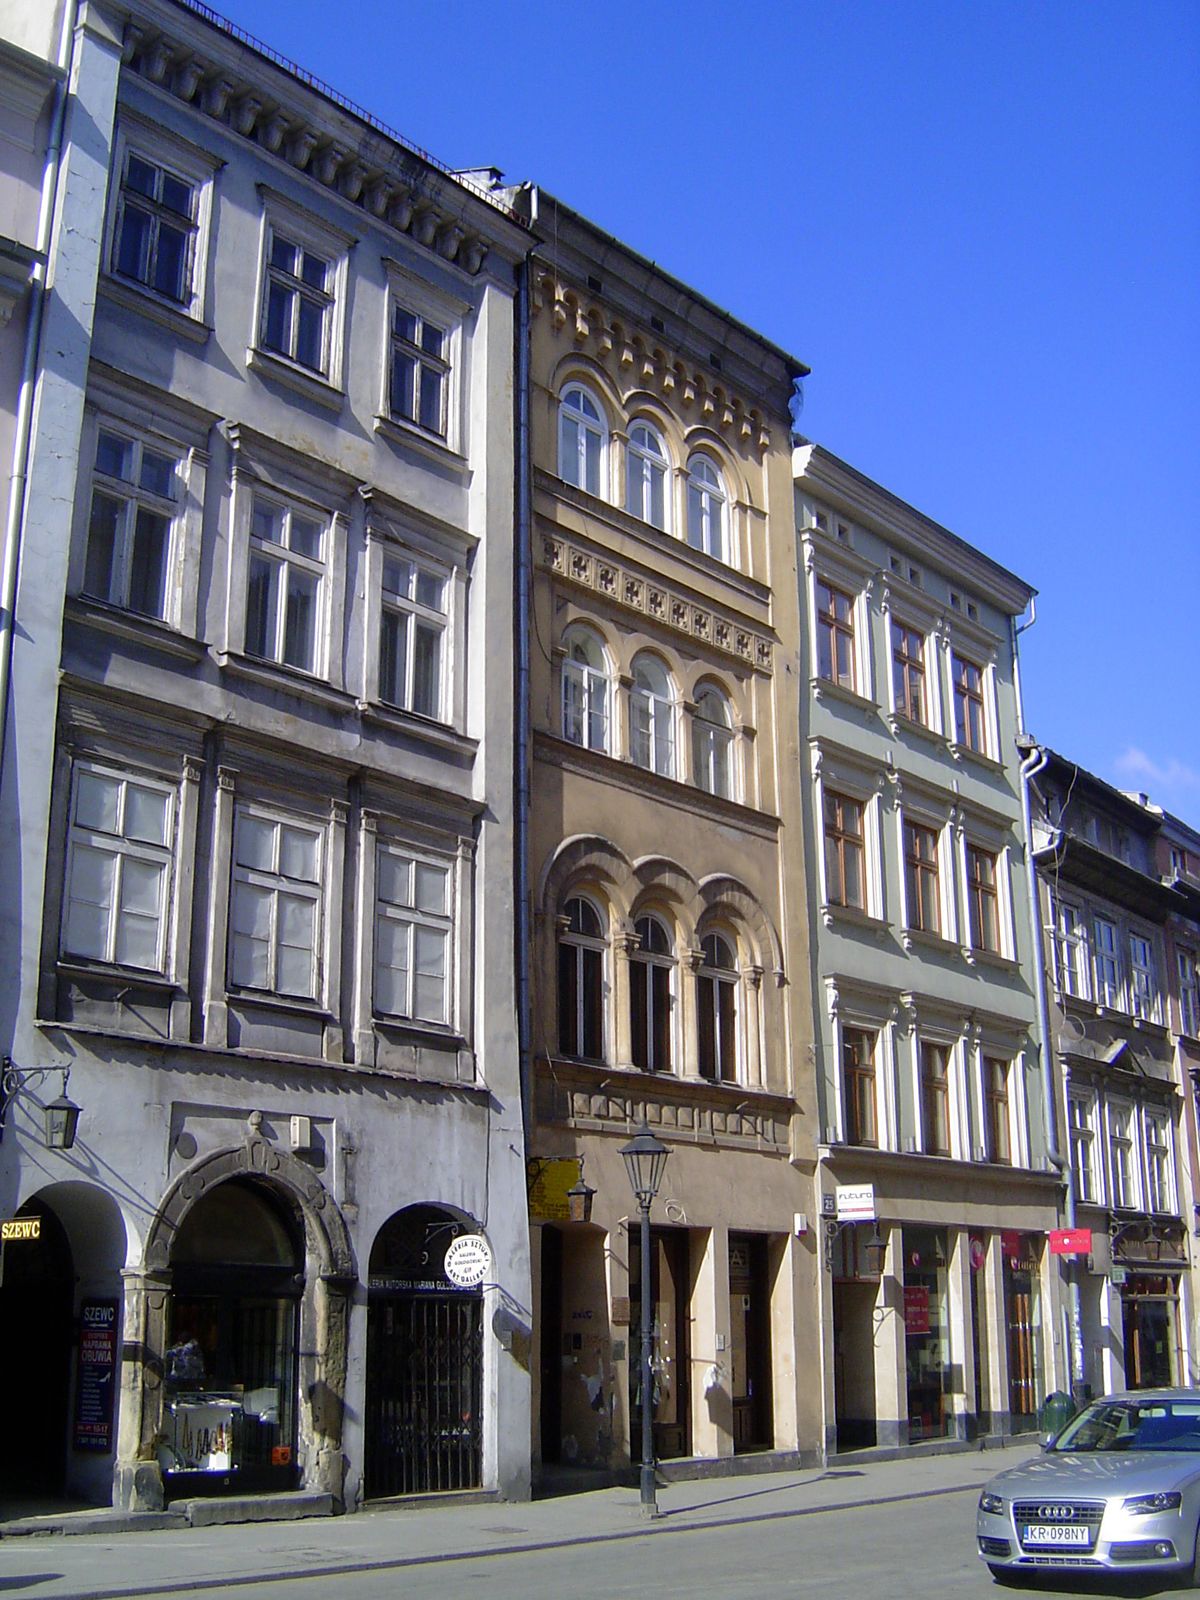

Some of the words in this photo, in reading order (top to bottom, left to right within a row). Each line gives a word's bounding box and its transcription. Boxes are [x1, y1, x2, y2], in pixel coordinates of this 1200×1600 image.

[1, 1221, 40, 1239] SZEWC
[84, 1306, 115, 1322] SZEWC
[81, 1350, 113, 1363] OBUWIA
[1030, 1527, 1046, 1540] KR
[1050, 1527, 1086, 1541] 098NY
